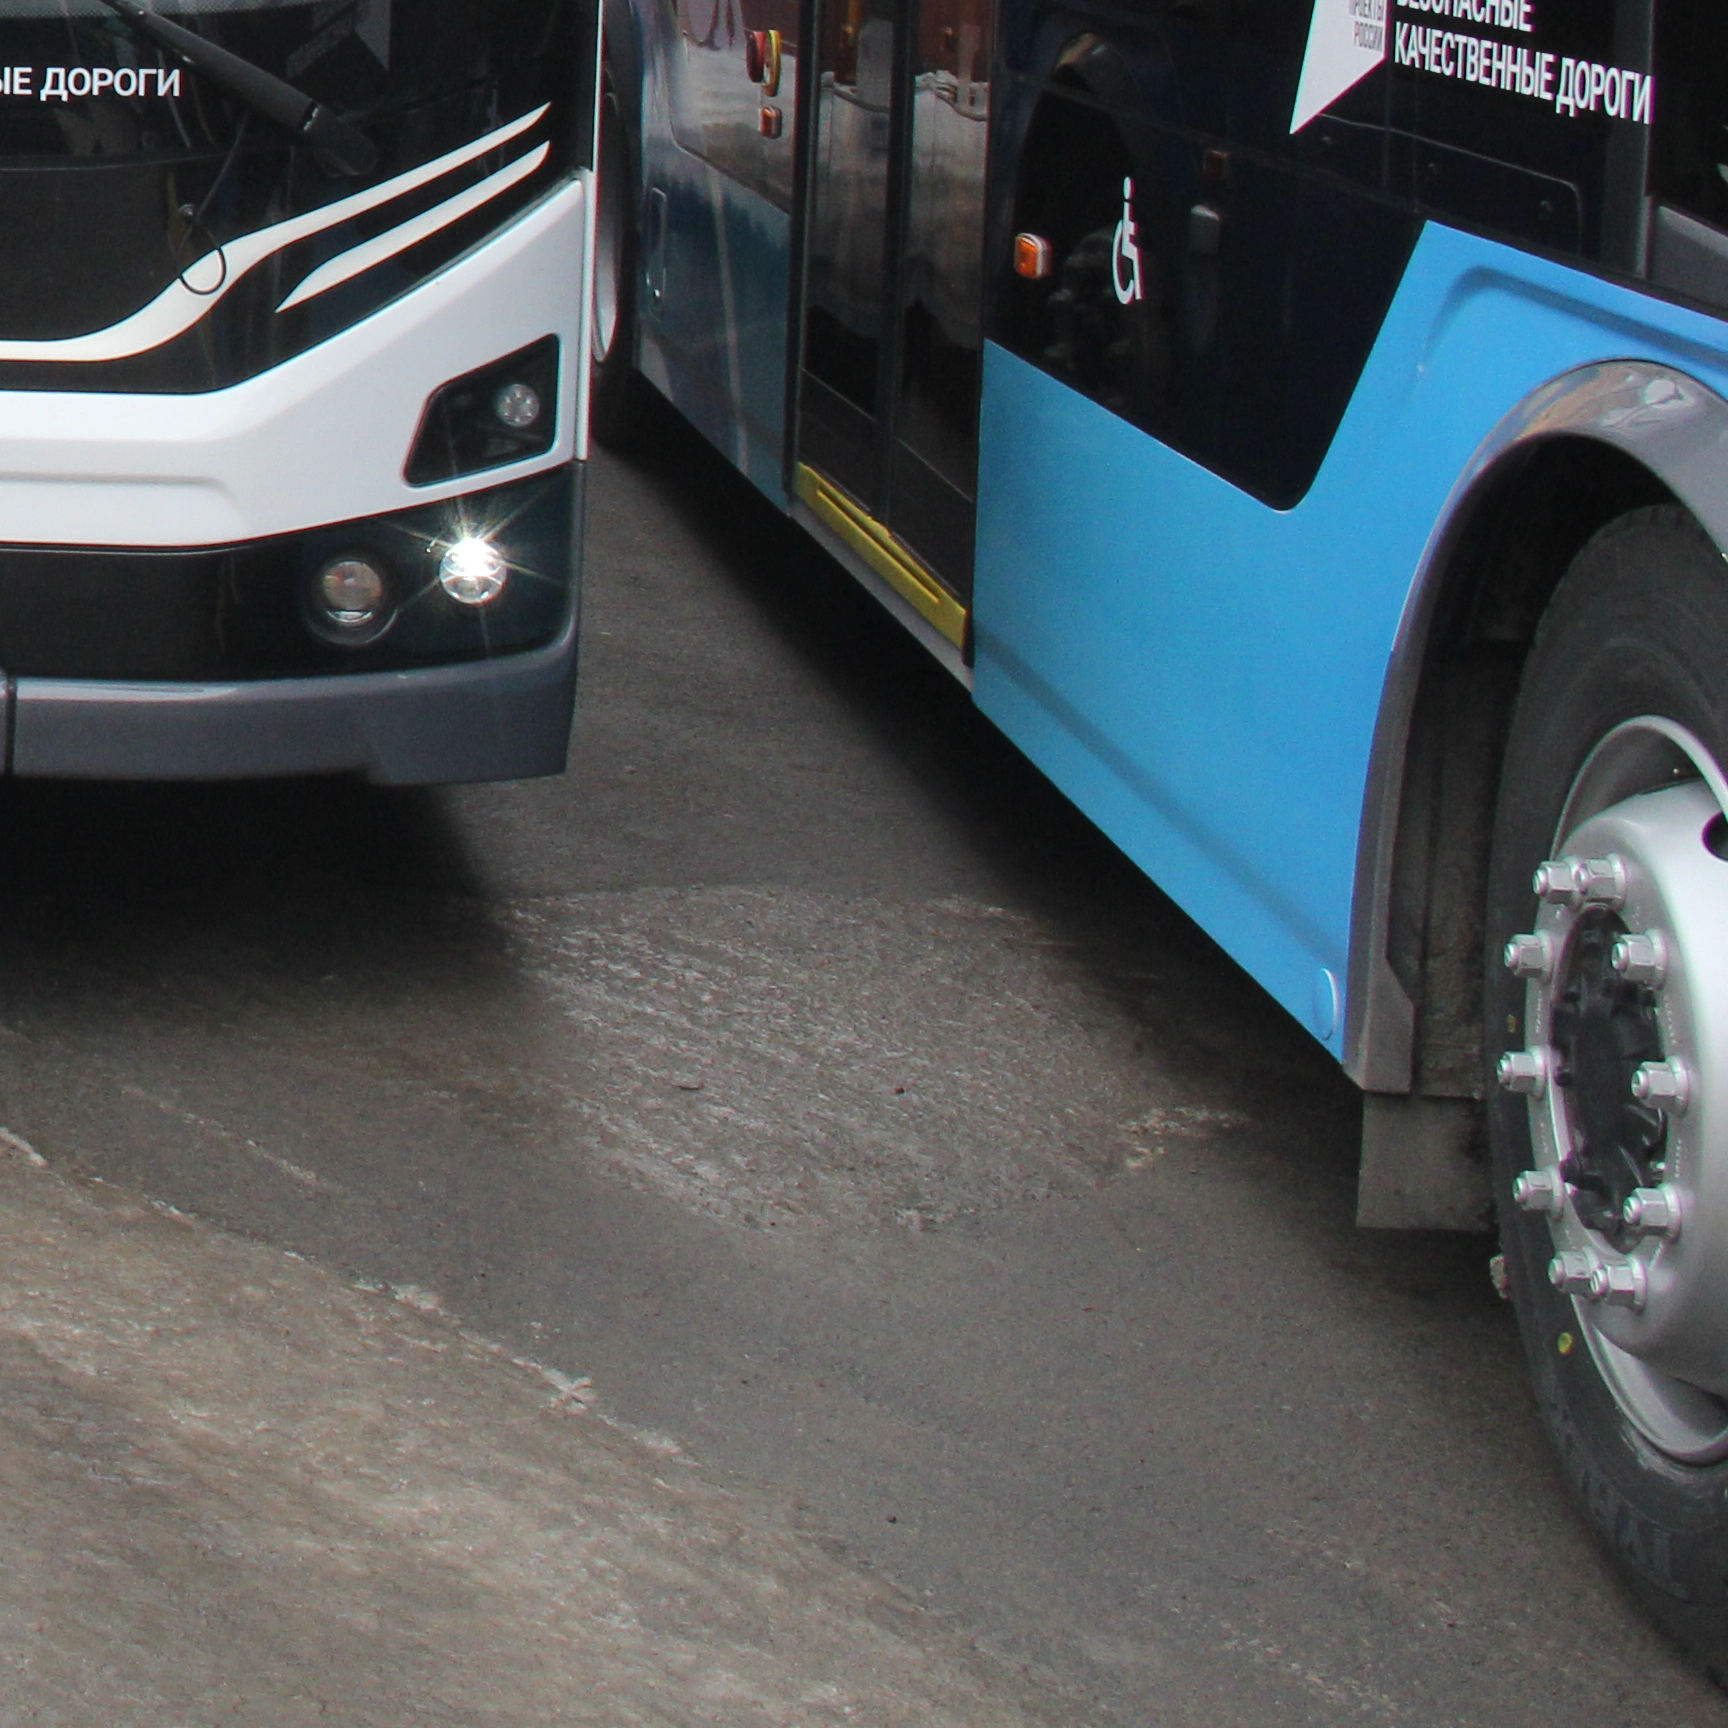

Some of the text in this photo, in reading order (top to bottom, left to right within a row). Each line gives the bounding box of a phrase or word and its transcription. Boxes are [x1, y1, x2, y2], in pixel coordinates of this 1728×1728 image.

[40, 67, 181, 101] ДОРОГИ
[1394, 21, 1656, 125] КАЧЕСТВЕННЫЕ ДОРОГИ
